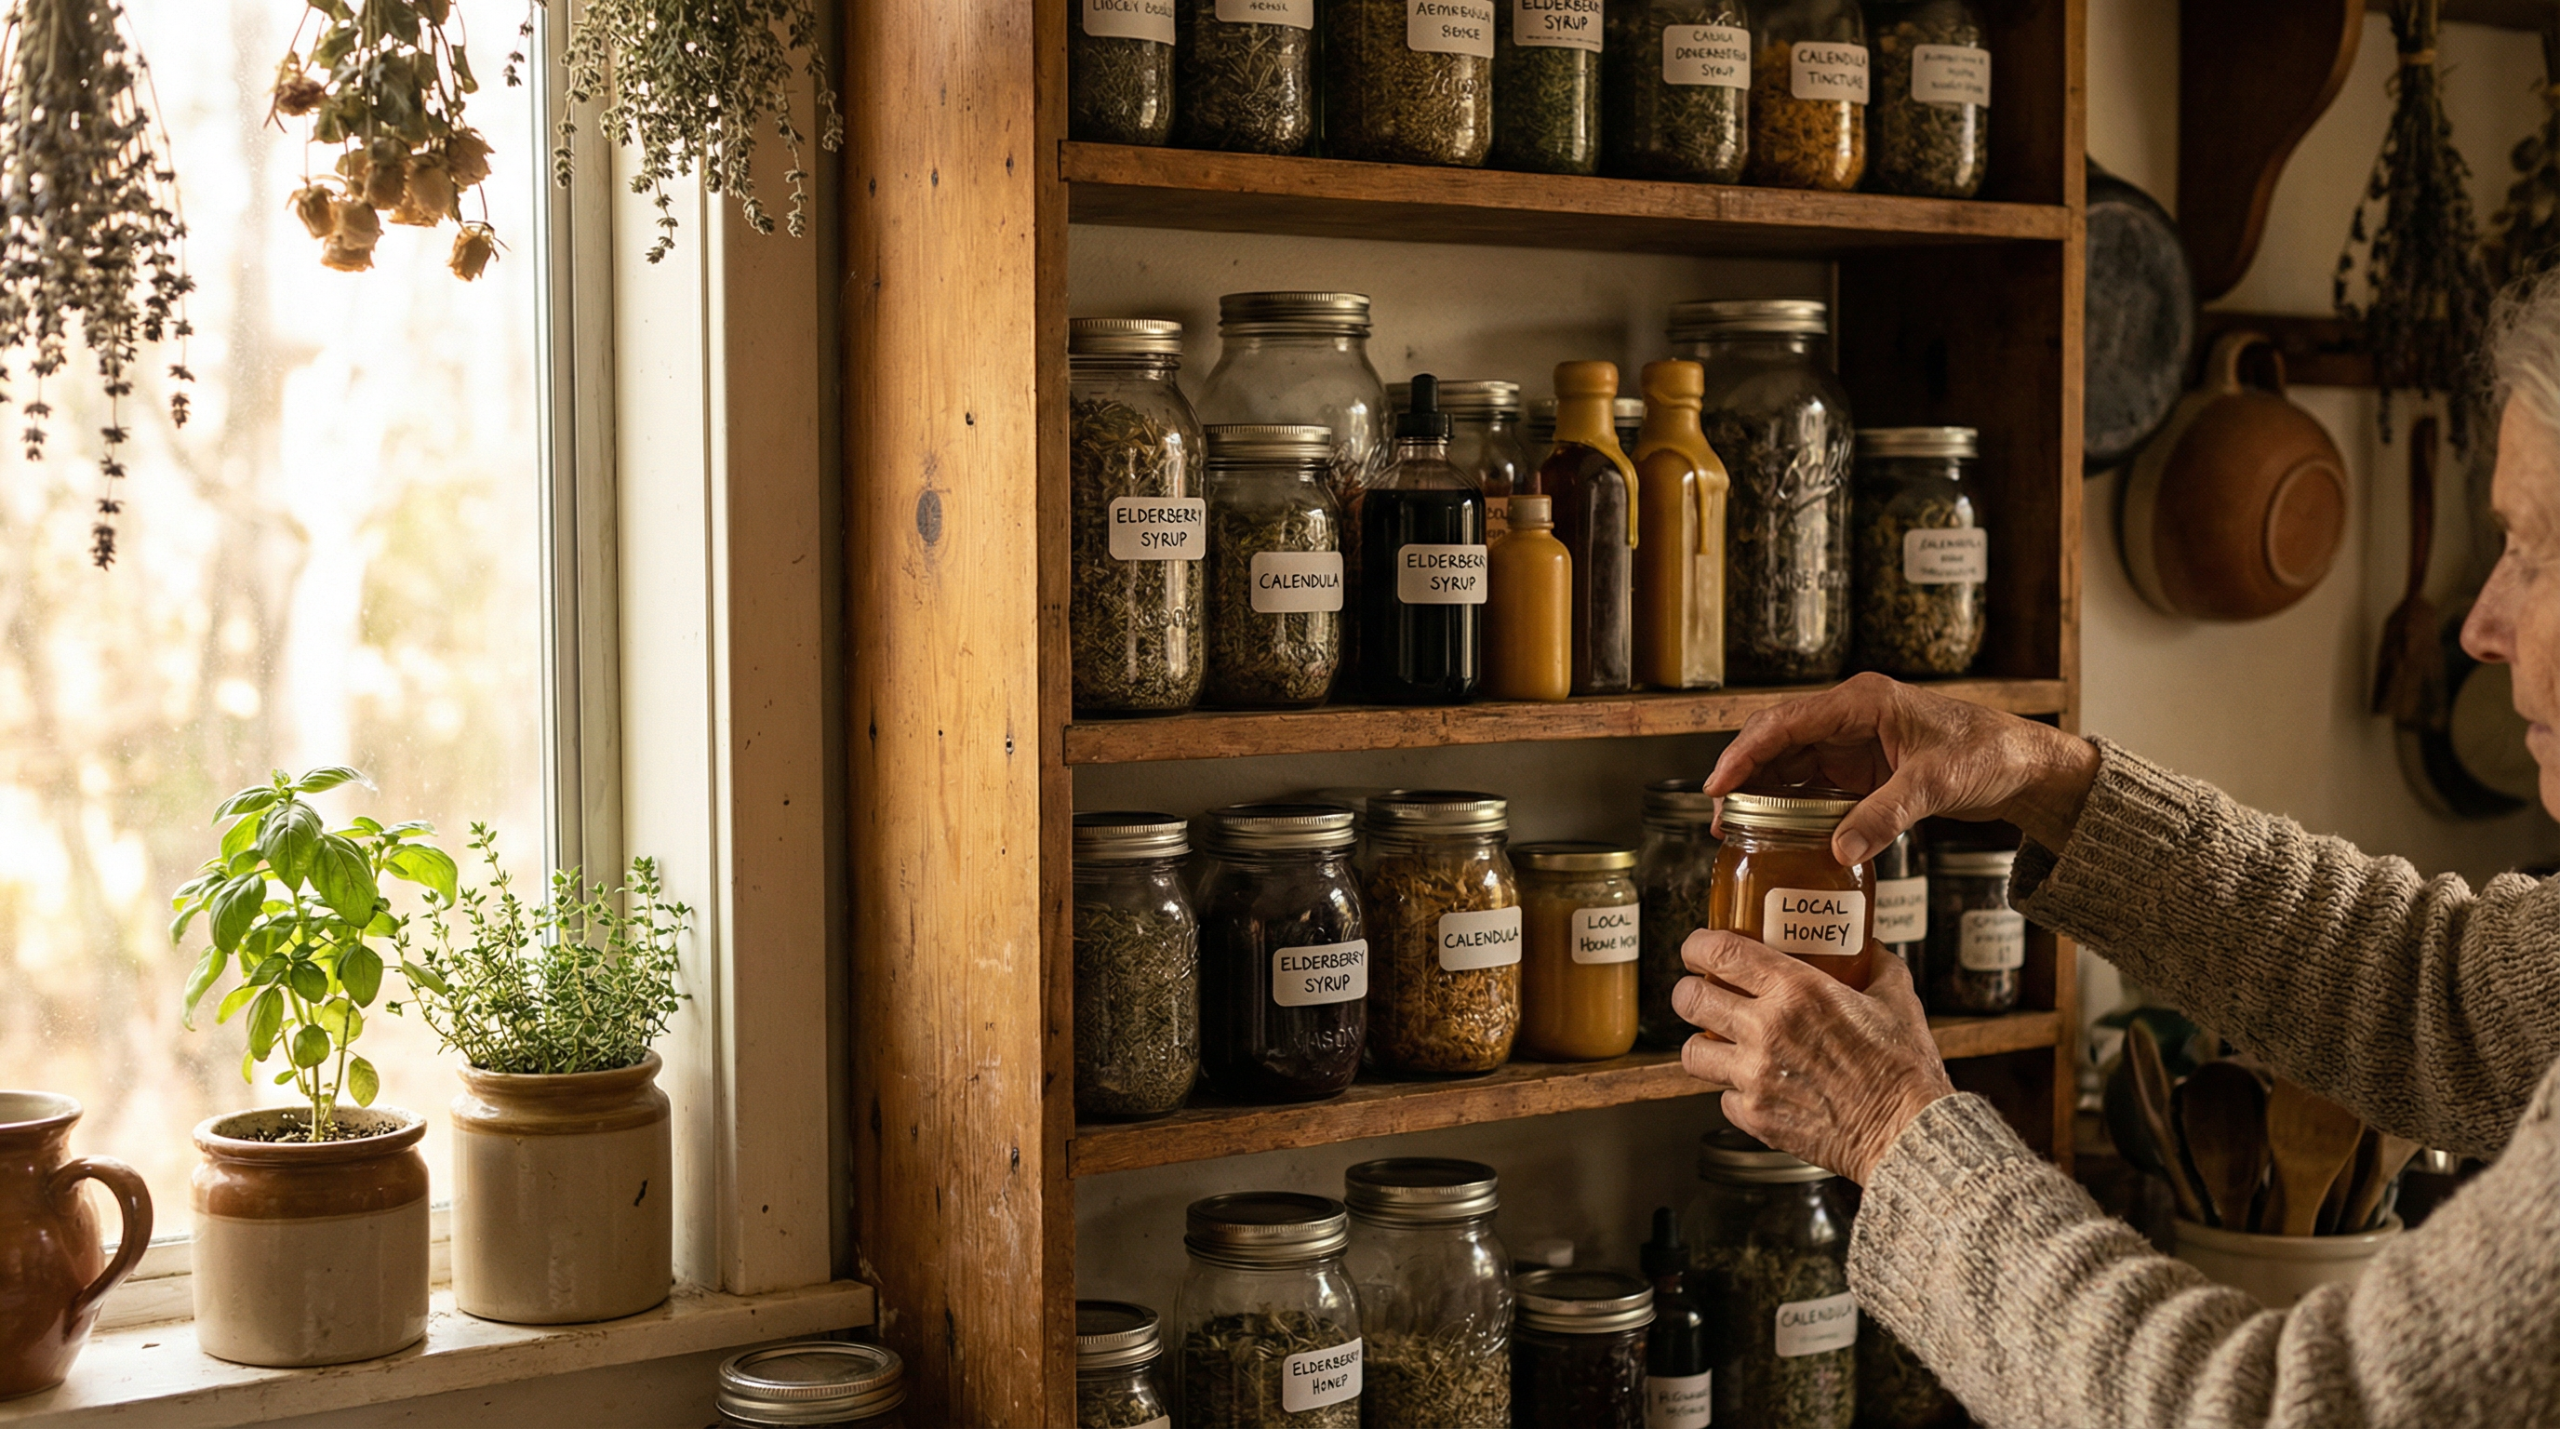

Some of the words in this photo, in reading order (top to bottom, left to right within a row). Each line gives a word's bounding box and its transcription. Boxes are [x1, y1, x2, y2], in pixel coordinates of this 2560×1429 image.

[1544, 14, 1588, 32] SYRUP
[1141, 531, 1188, 549] SYRUP
[1259, 573, 1340, 590] CALENDULA
[1430, 576, 1476, 593] SYRUP
[1782, 896, 1849, 916] LOCAL
[1588, 914, 1632, 929] LOCAL
[1444, 926, 1519, 949] CALENDULA
[1784, 922, 1851, 947] HONEY
[1304, 974, 1350, 994] SYRUP
